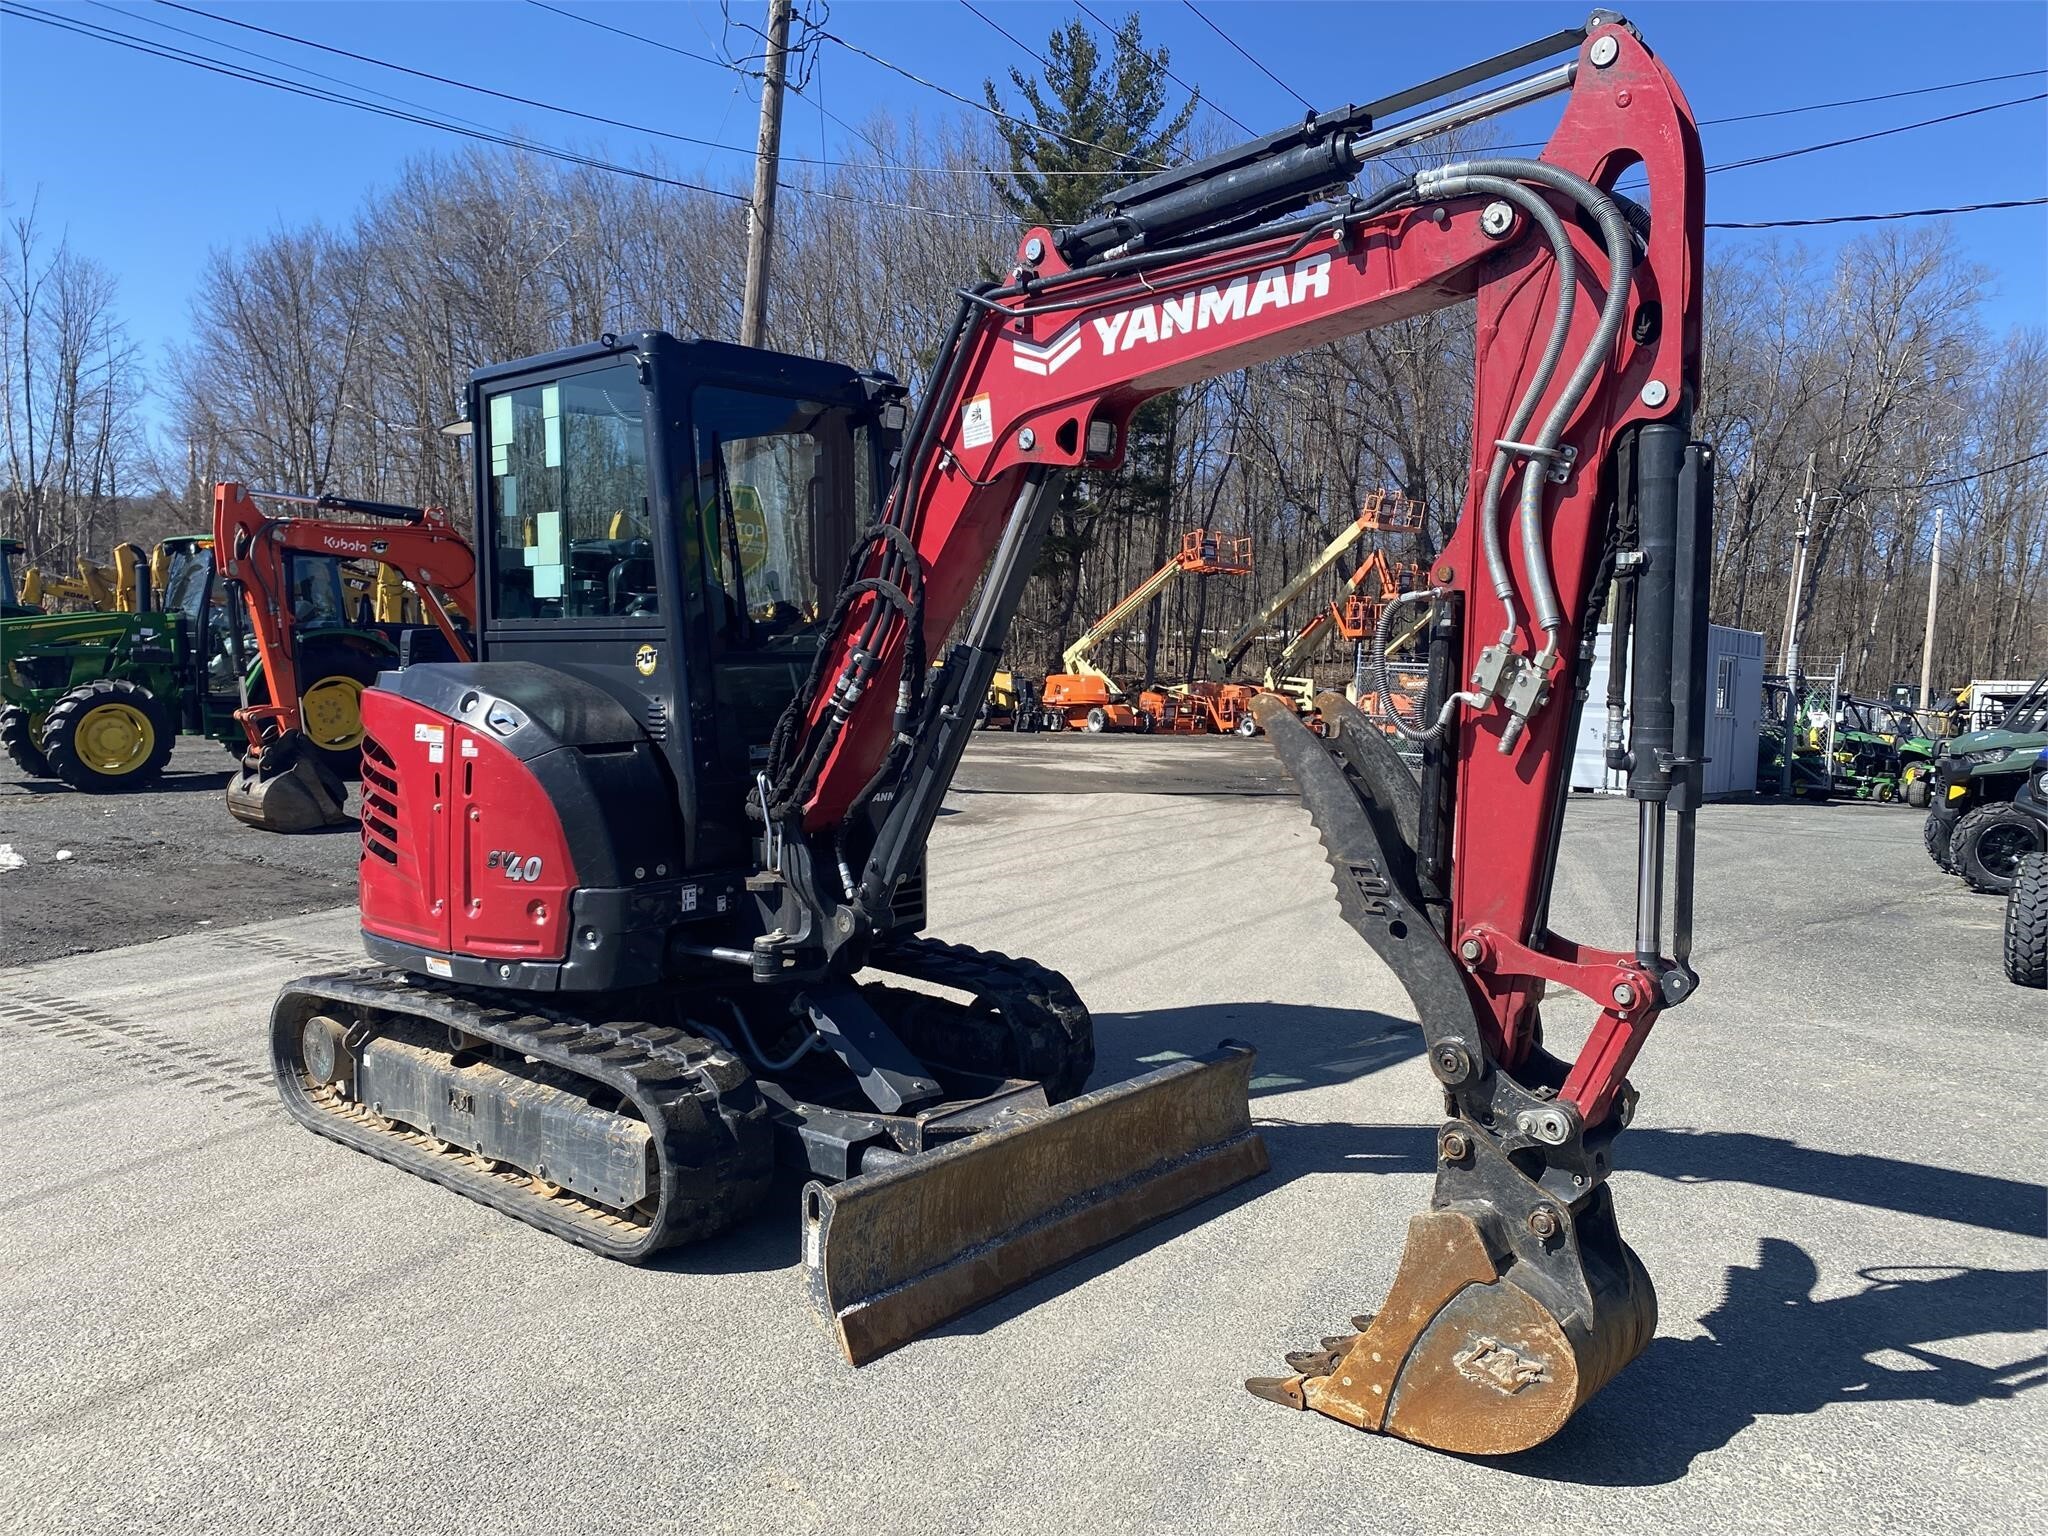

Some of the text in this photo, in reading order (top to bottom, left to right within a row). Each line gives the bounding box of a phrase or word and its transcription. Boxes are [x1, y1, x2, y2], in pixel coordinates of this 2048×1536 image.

[1093, 252, 1332, 356] YANMAR
[735, 521, 764, 538] TOP
[323, 535, 367, 552] Kubota
[350, 579, 365, 591] CAT
[636, 650, 657, 666] PLT
